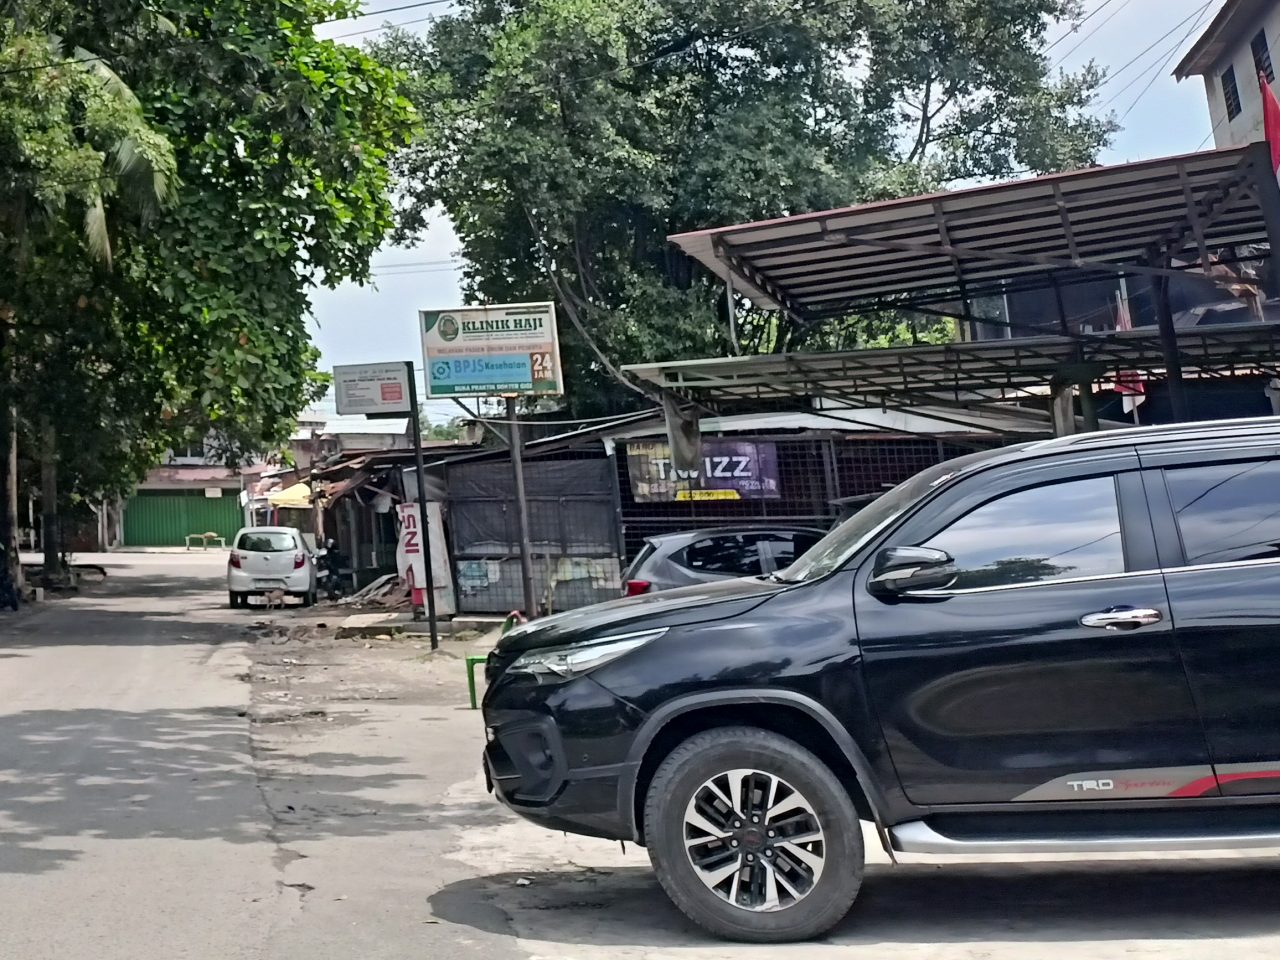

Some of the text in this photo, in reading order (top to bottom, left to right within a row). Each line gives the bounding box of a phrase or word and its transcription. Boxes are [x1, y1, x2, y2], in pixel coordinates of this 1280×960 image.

[462, 317, 543, 331] KLINIK HAJI
[454, 358, 527, 373] BPJS Kesehatan
[532, 353, 552, 371] 24
[533, 369, 553, 379] JAM
[1066, 779, 1114, 791] TRD
